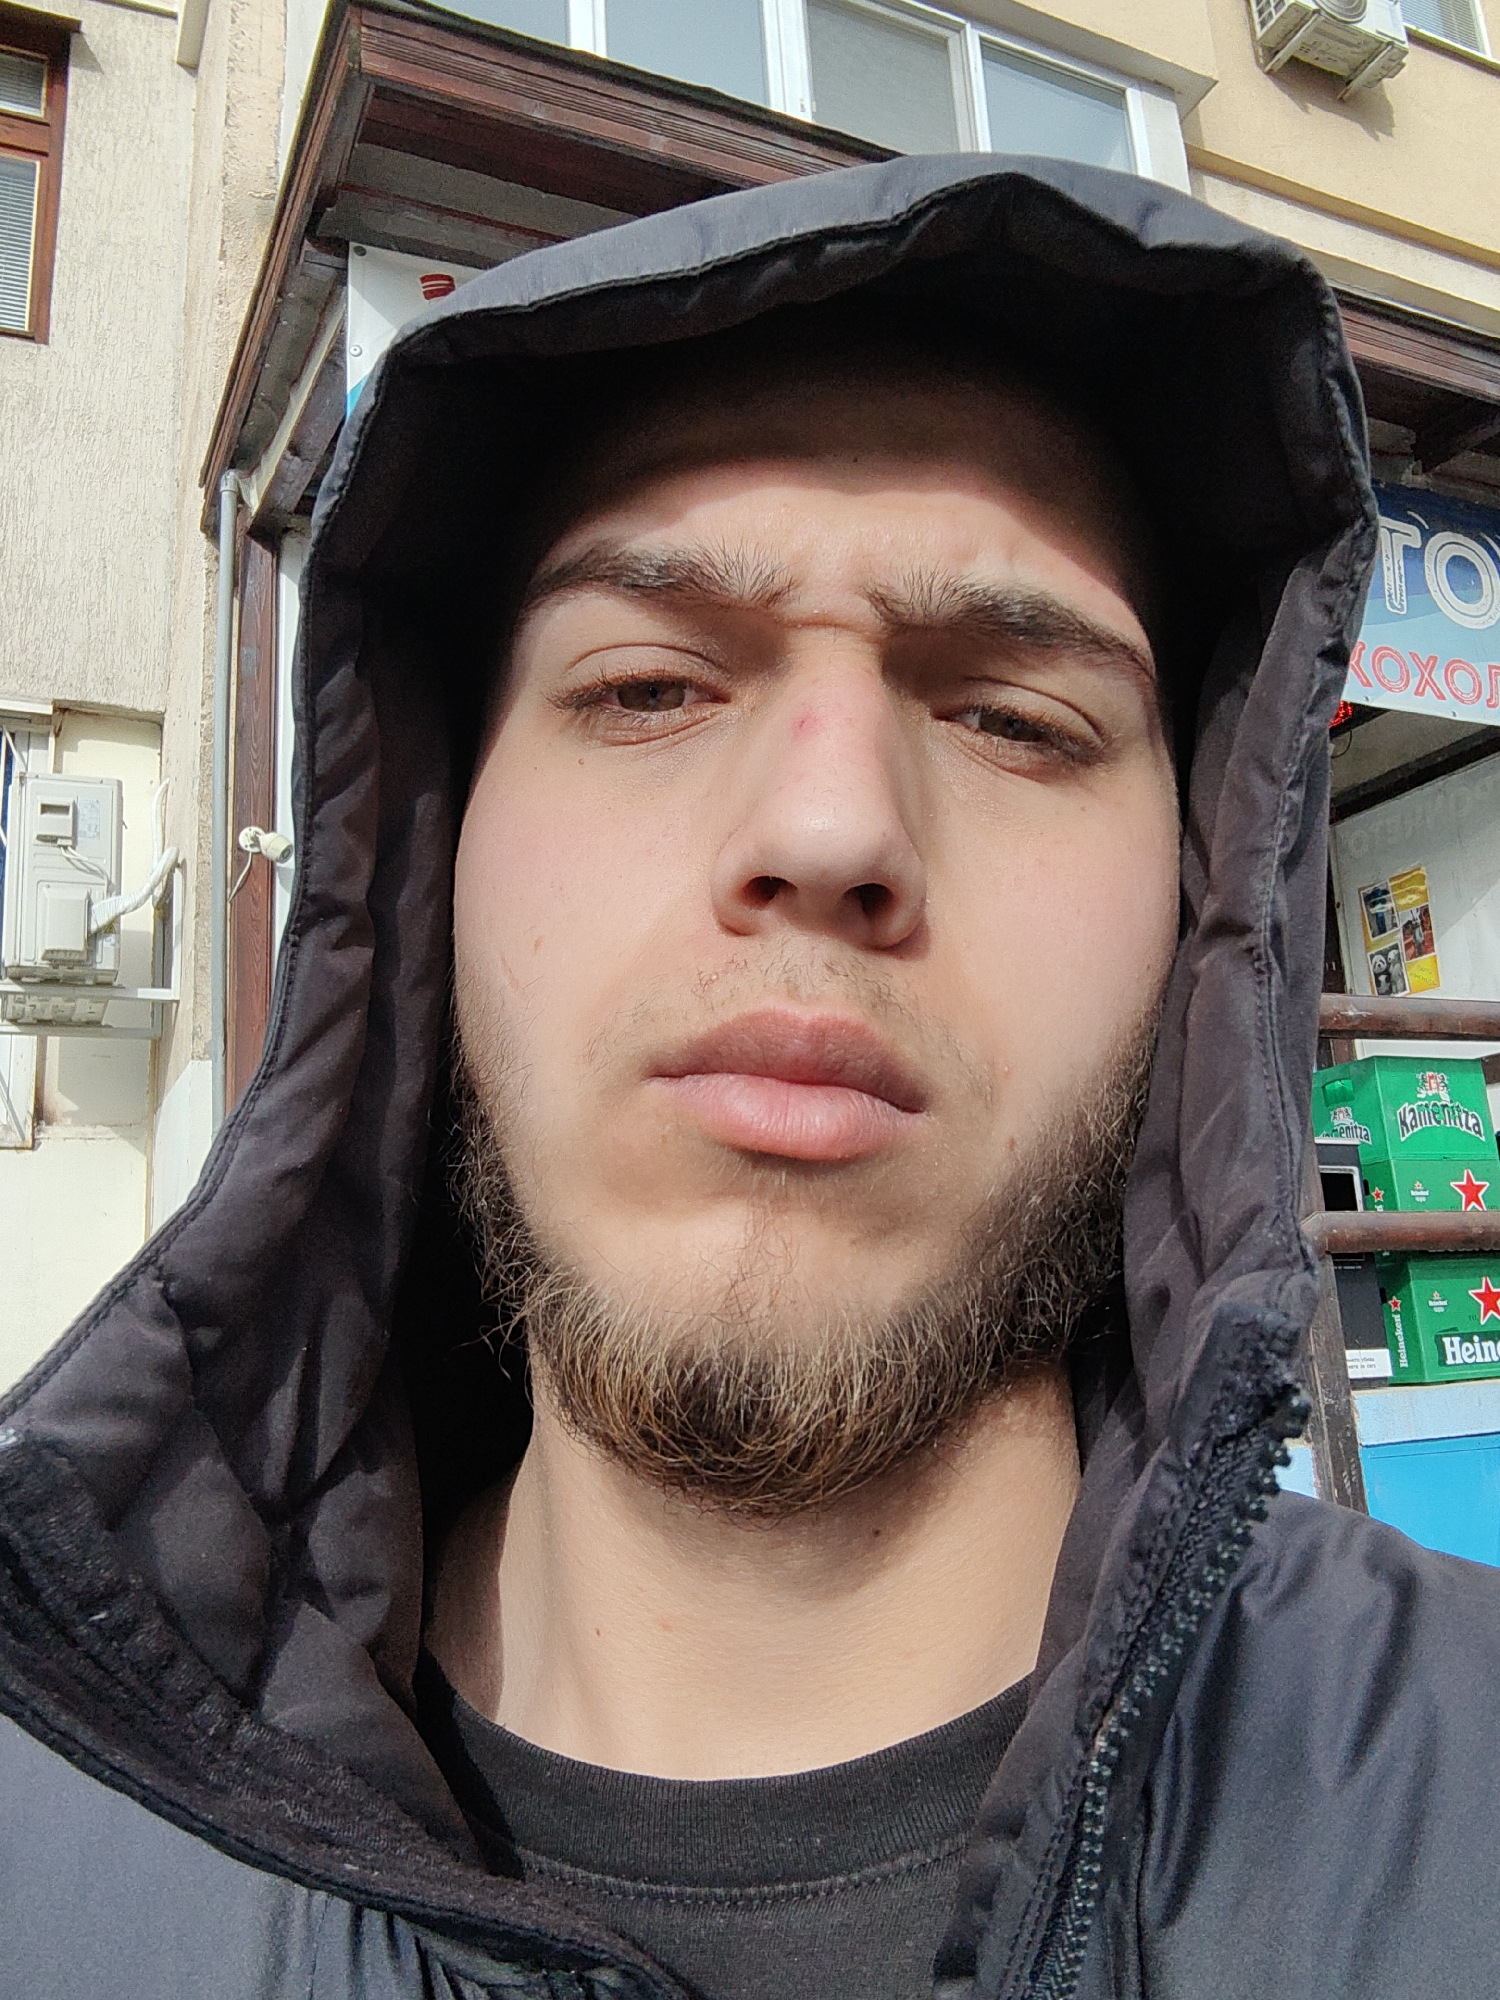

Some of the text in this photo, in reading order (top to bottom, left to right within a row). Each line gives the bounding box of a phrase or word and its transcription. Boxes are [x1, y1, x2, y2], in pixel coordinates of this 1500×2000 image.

[1321, 1120, 1372, 1145] menitza
[1397, 1100, 1486, 1142] Kamenitza
[1392, 1313, 1409, 1369] Heineken
[1442, 1334, 1500, 1366] Hein
